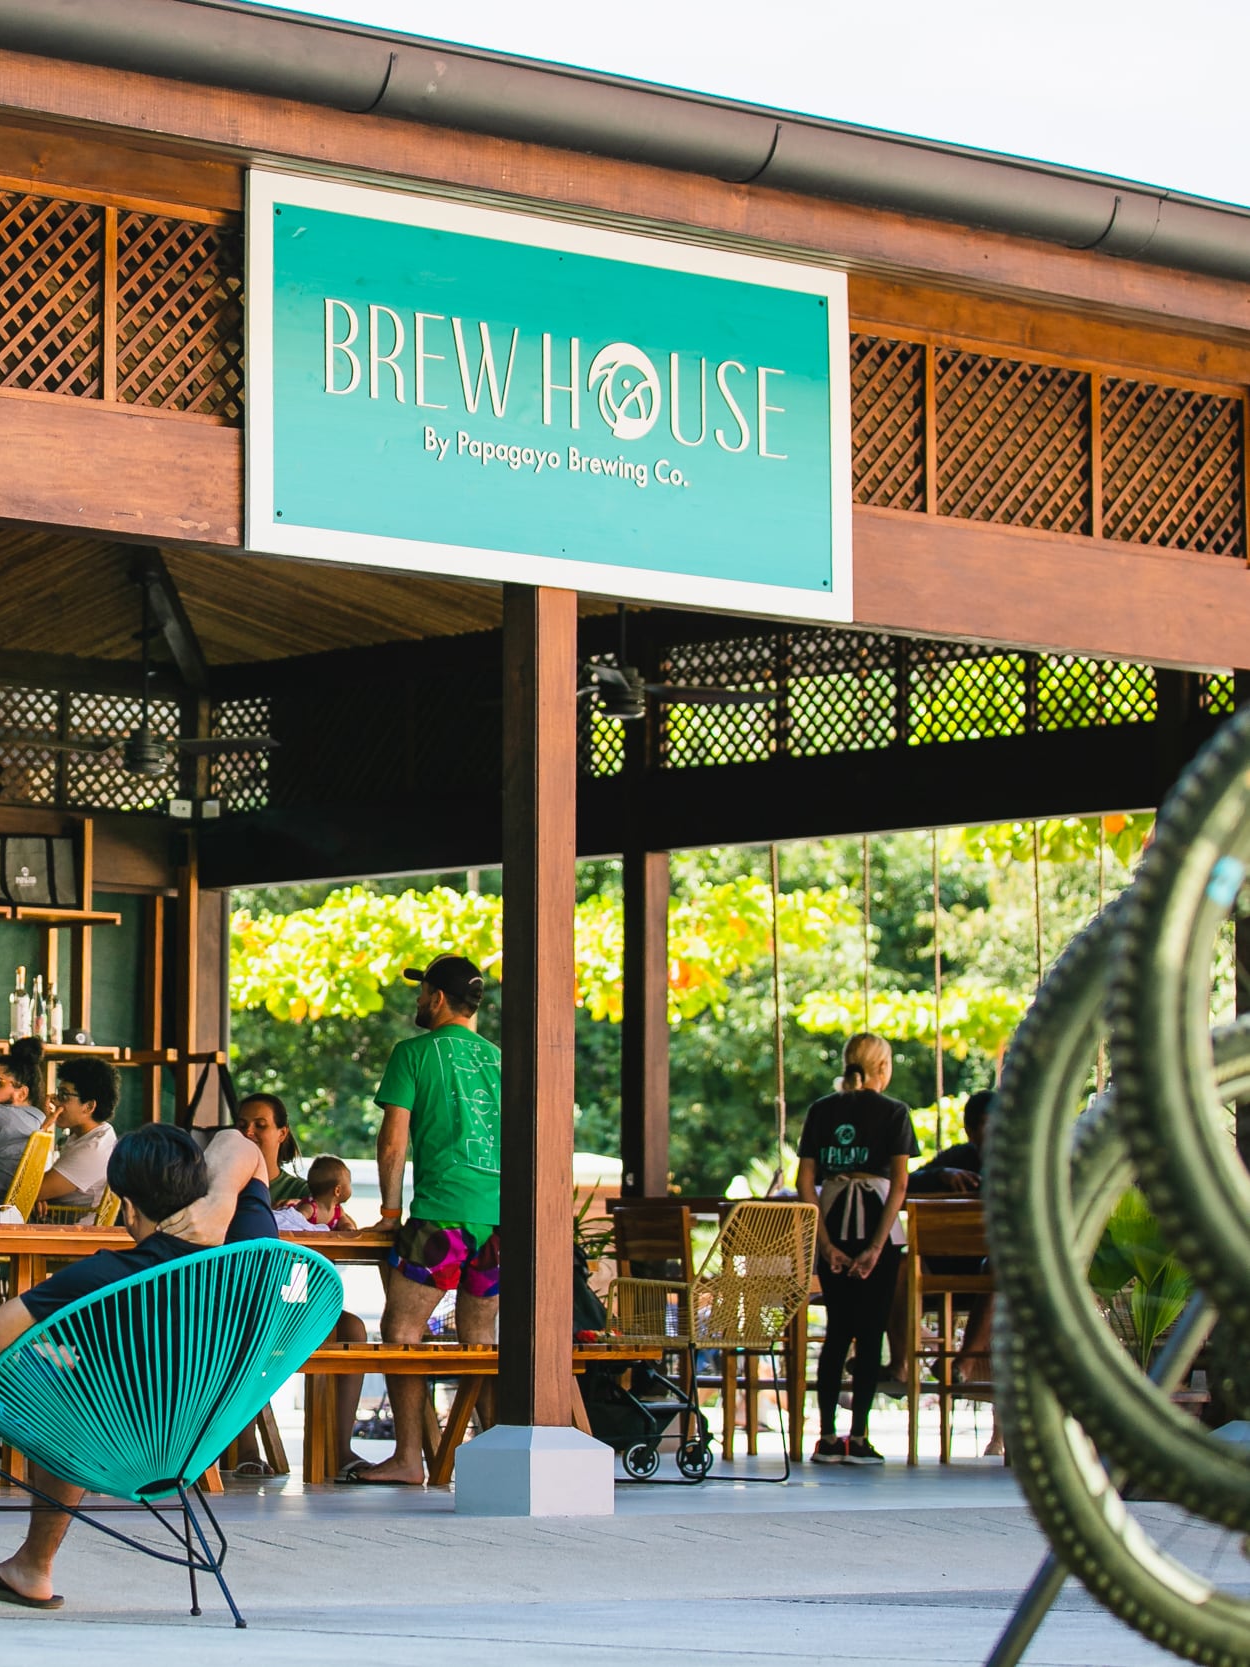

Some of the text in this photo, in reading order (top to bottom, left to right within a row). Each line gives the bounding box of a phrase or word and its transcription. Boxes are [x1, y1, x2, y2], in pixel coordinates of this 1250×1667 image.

[323, 297, 788, 460] BREW HOUSE
[423, 425, 691, 488] By Papagayo Brewing Co.
